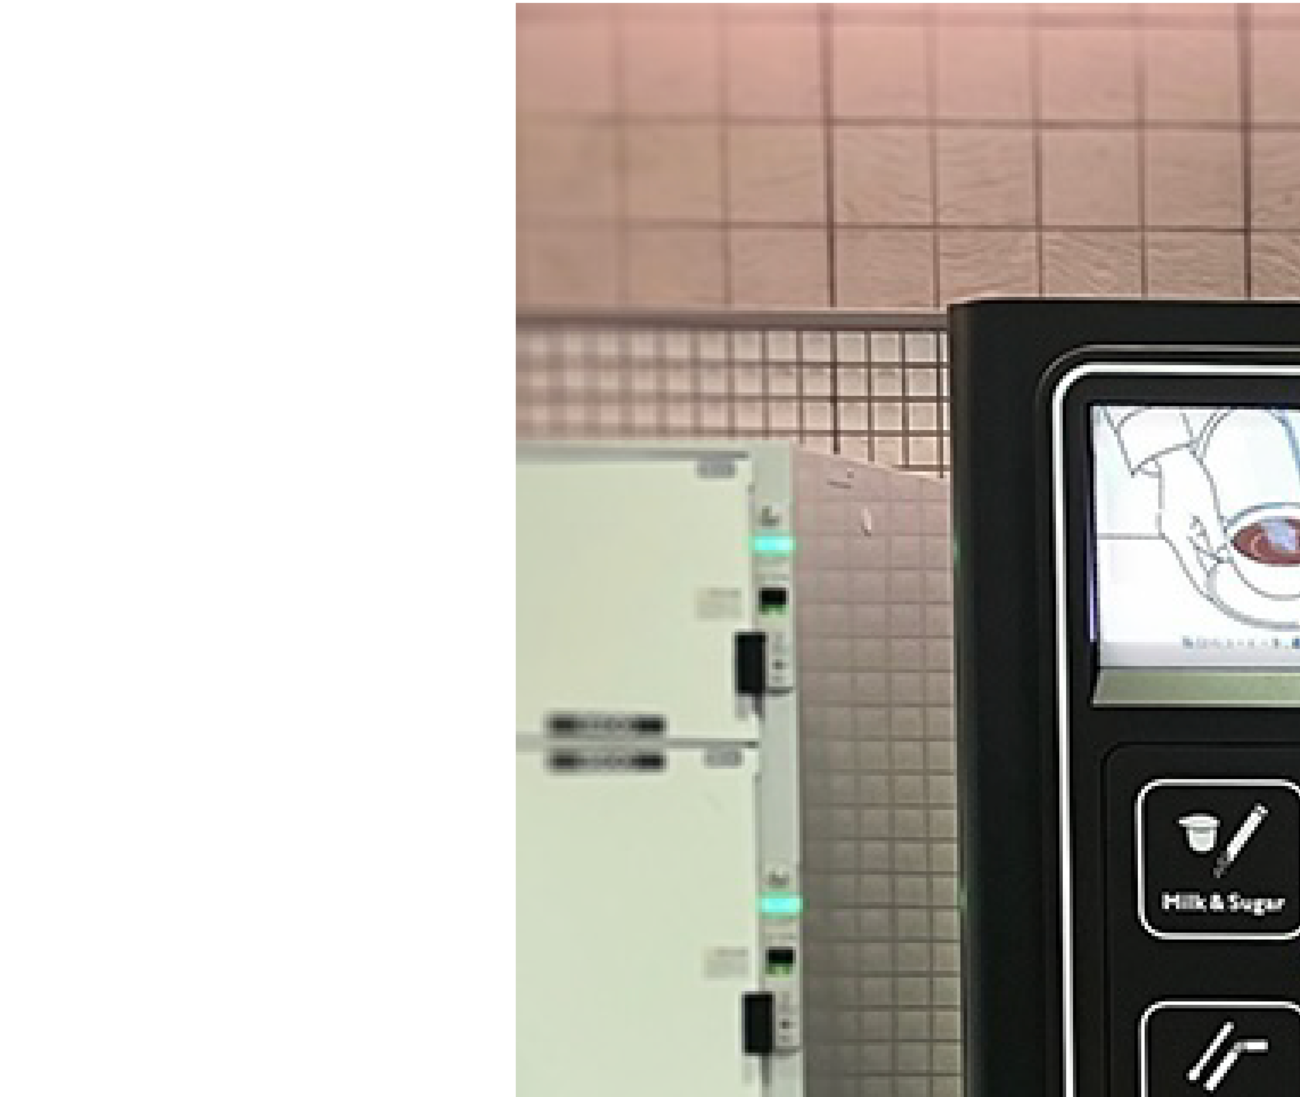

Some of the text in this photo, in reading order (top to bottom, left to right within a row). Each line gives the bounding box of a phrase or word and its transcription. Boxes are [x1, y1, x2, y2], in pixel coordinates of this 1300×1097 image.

[1161, 892, 1286, 917] Milk & Sugar
